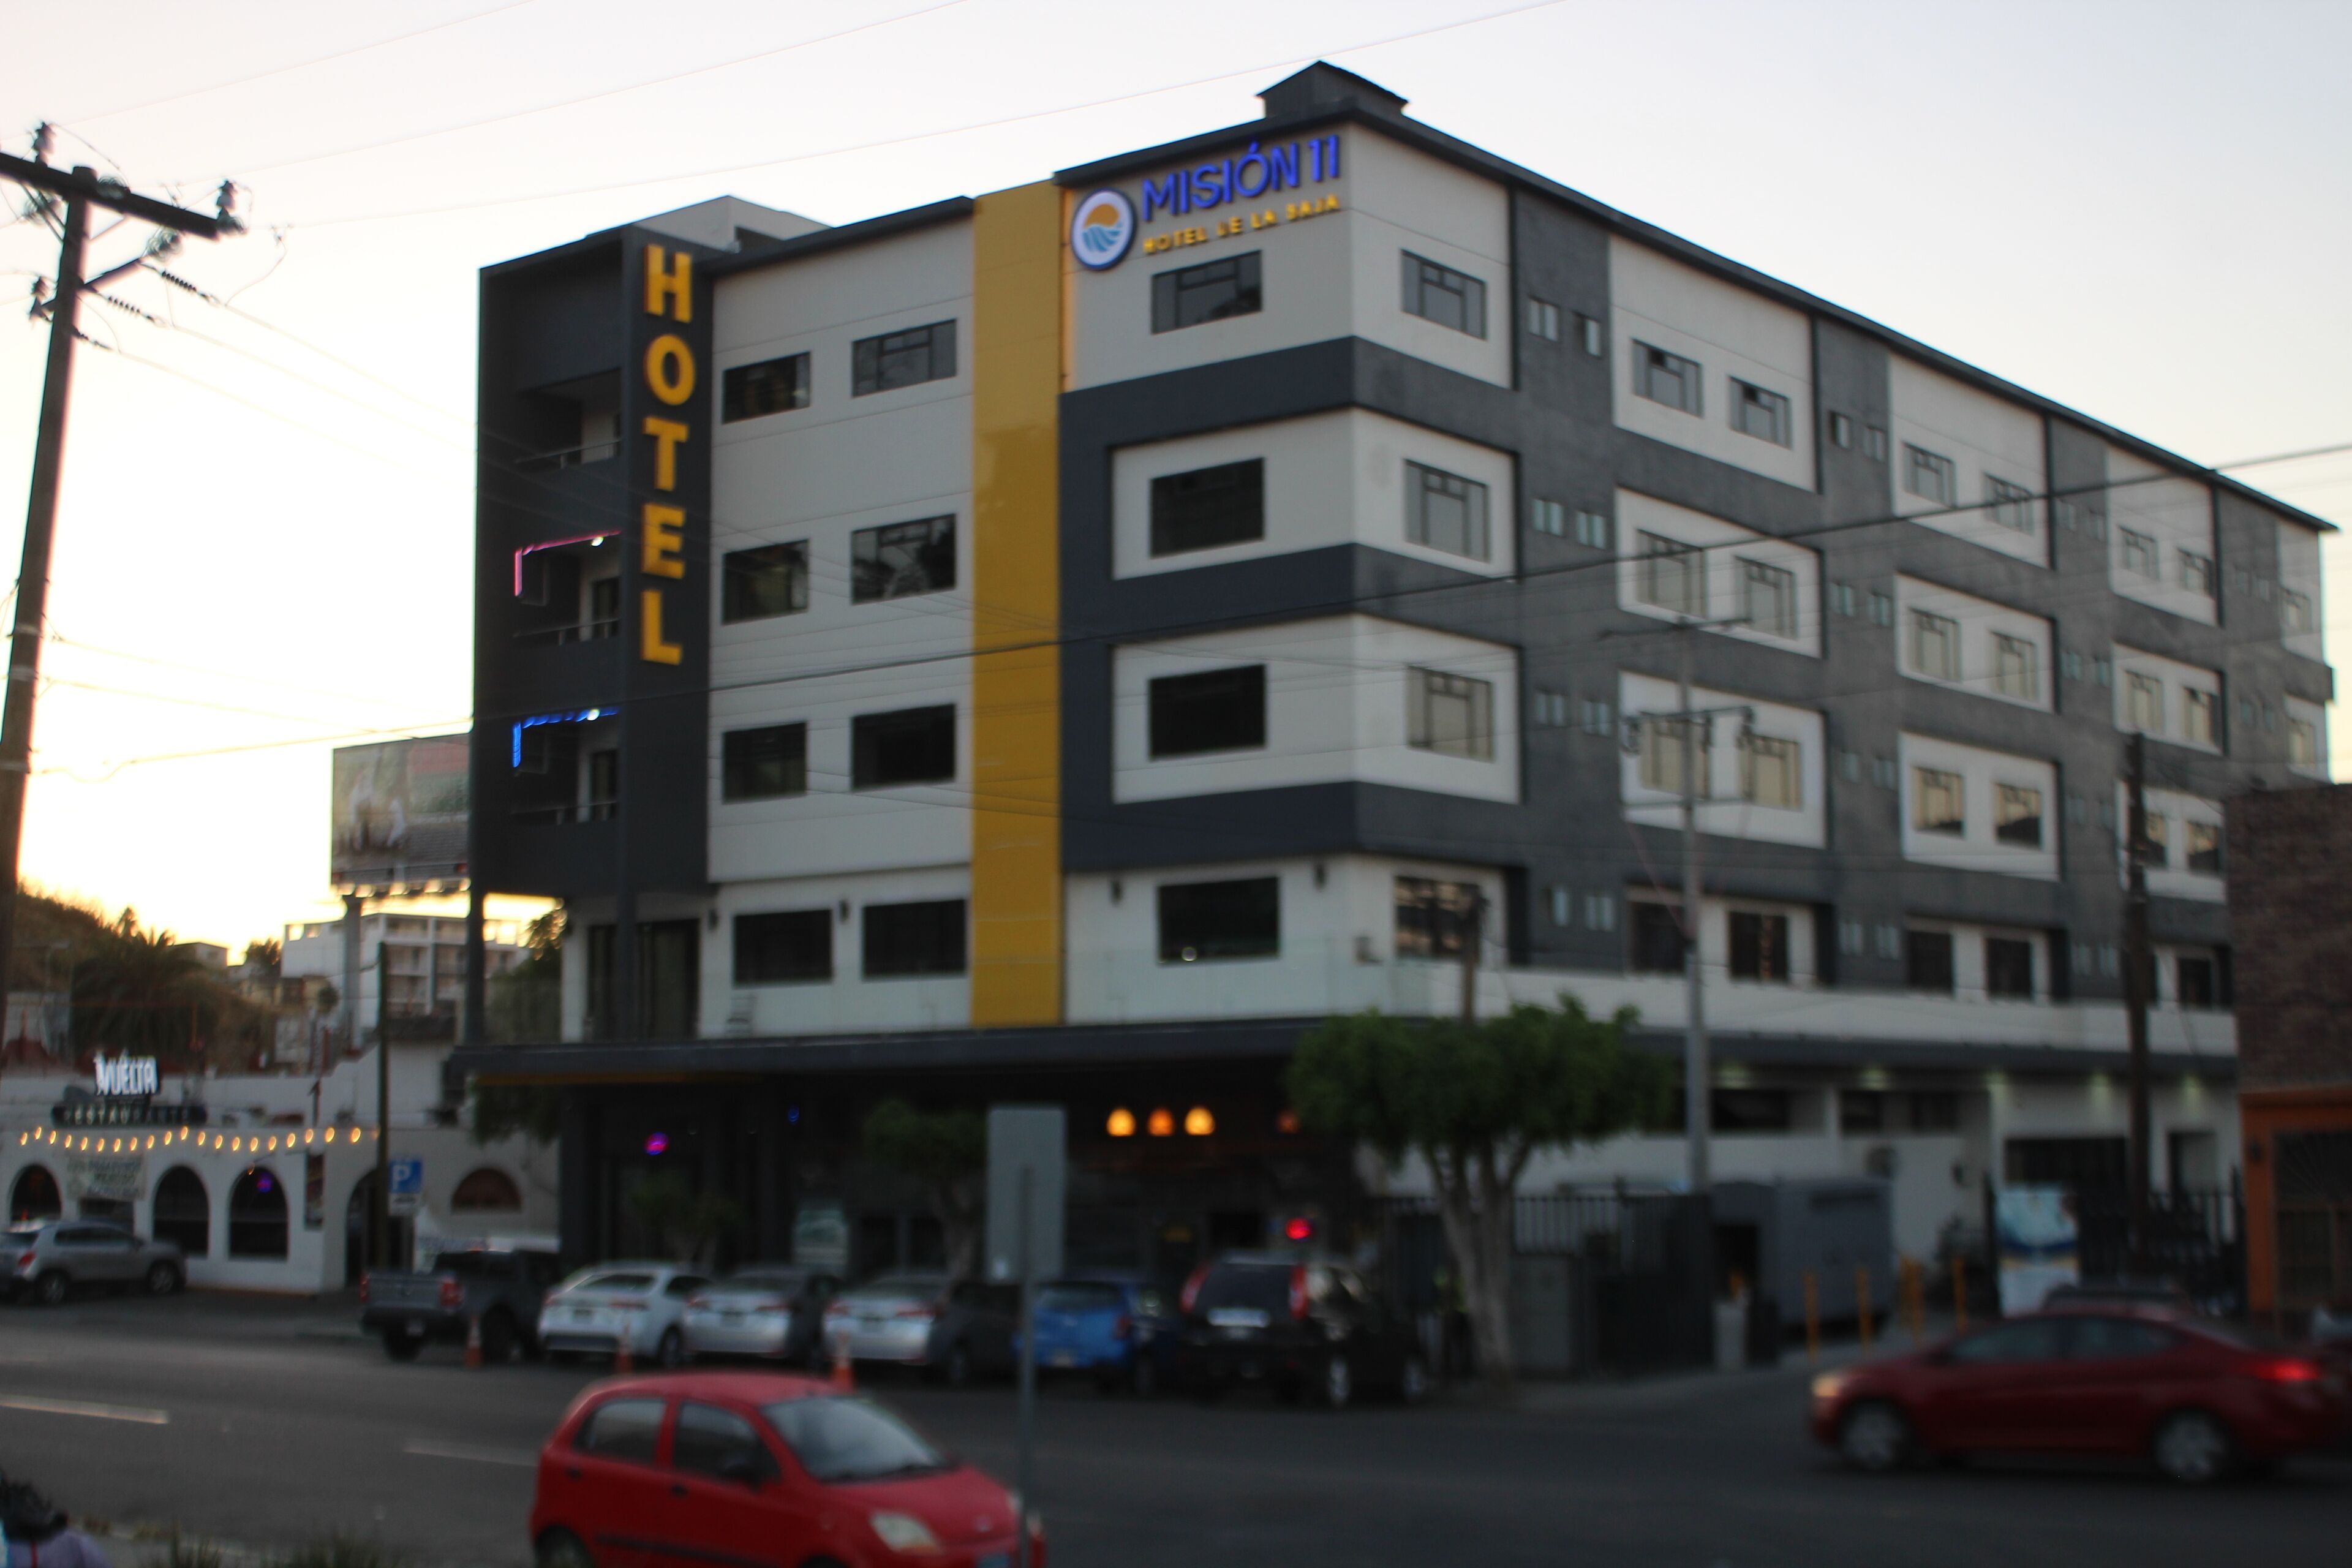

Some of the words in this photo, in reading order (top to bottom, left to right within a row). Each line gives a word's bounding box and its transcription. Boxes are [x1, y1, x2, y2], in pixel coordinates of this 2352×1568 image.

[1142, 140, 1298, 222] MISIÓN
[1142, 227, 1207, 254] HOTEL
[1216, 216, 1243, 237] DE
[1250, 209, 1278, 229] LA
[1286, 194, 1340, 220] BAJA
[641, 244, 696, 666] HOTEL
[392, 1164, 410, 1191] P
